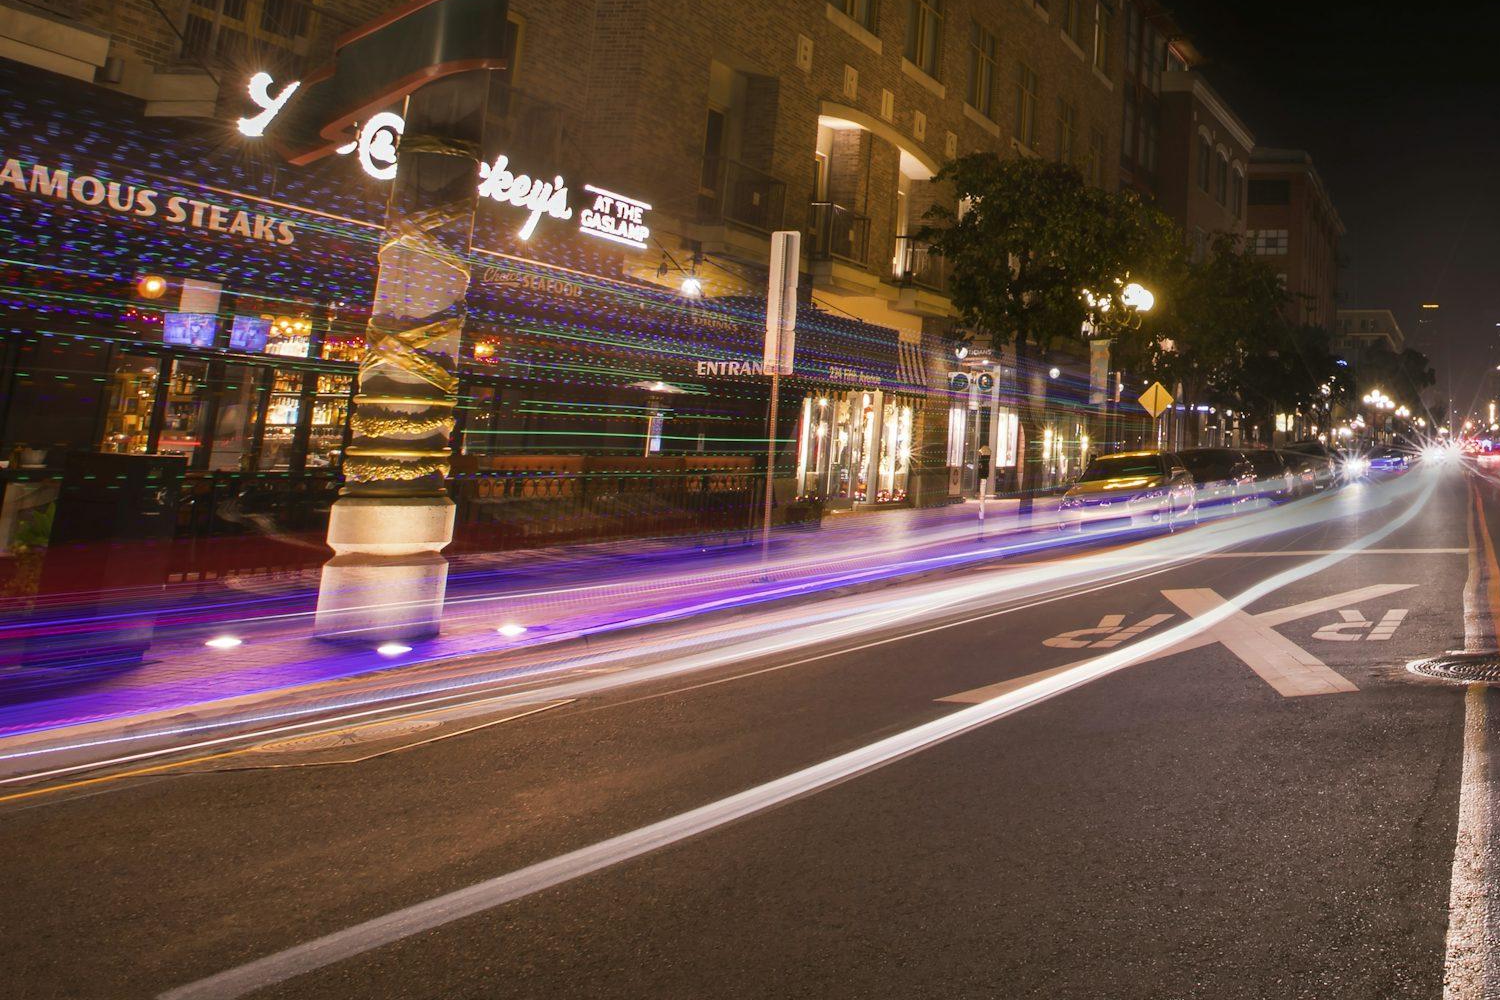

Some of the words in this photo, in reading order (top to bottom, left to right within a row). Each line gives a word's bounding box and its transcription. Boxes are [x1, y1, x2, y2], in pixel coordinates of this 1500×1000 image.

[0, 158, 158, 217] AMOUS
[165, 196, 295, 245] STEAKS
[593, 195, 615, 214] AT
[615, 201, 644, 225] THE
[580, 208, 650, 242] GASLAMP
[522, 274, 582, 298] SEAFOOD
[697, 360, 764, 376] ENTRAN
